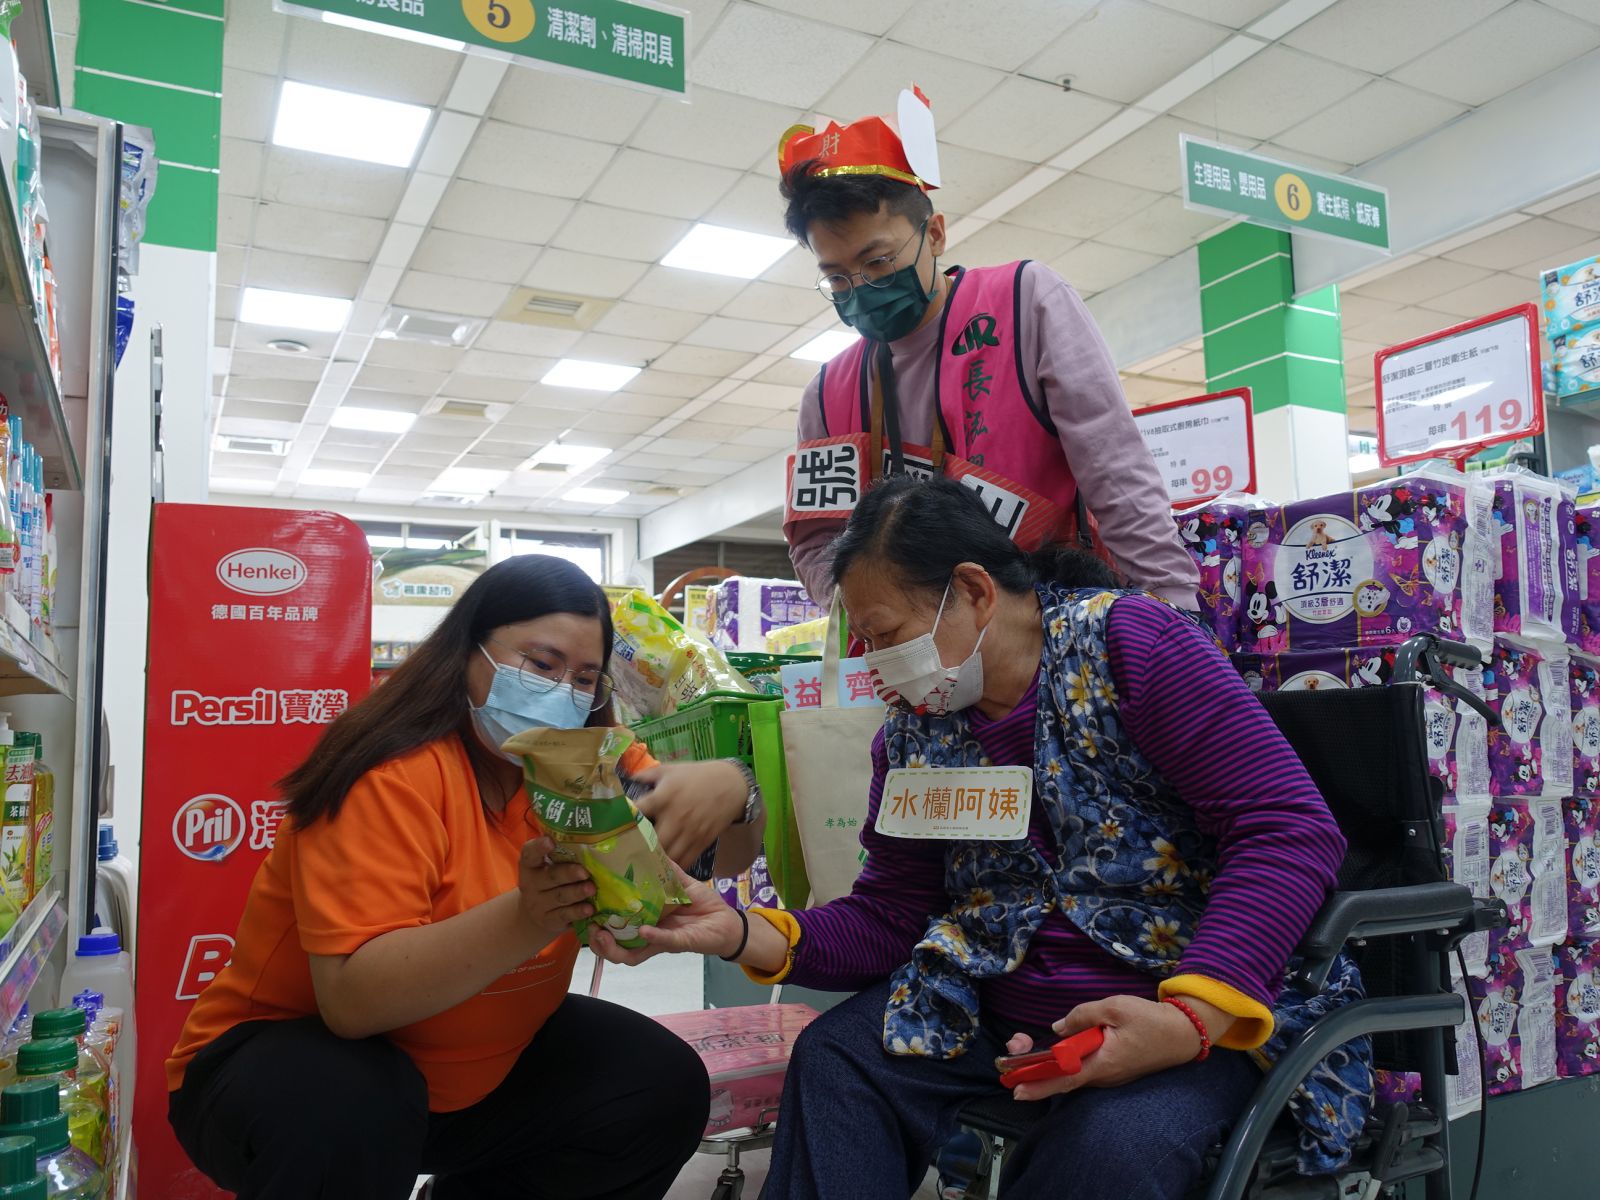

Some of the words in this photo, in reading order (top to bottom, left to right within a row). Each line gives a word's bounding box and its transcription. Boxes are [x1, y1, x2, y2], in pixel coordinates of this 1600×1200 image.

[487, 0, 511, 29] 5
[818, 132, 840, 158] 財
[1286, 183, 1300, 211] 6
[1450, 399, 1522, 441] 119
[1191, 465, 1233, 495] 99
[1305, 549, 1336, 560] Kleenex
[227, 562, 298, 580] Henkel
[1290, 558, 1352, 591] 舒潔
[211, 604, 319, 621] 德國百年品牌
[174, 689, 276, 725] Persil
[890, 786, 1020, 821] 水欄阿姨
[185, 807, 232, 848] Pril
